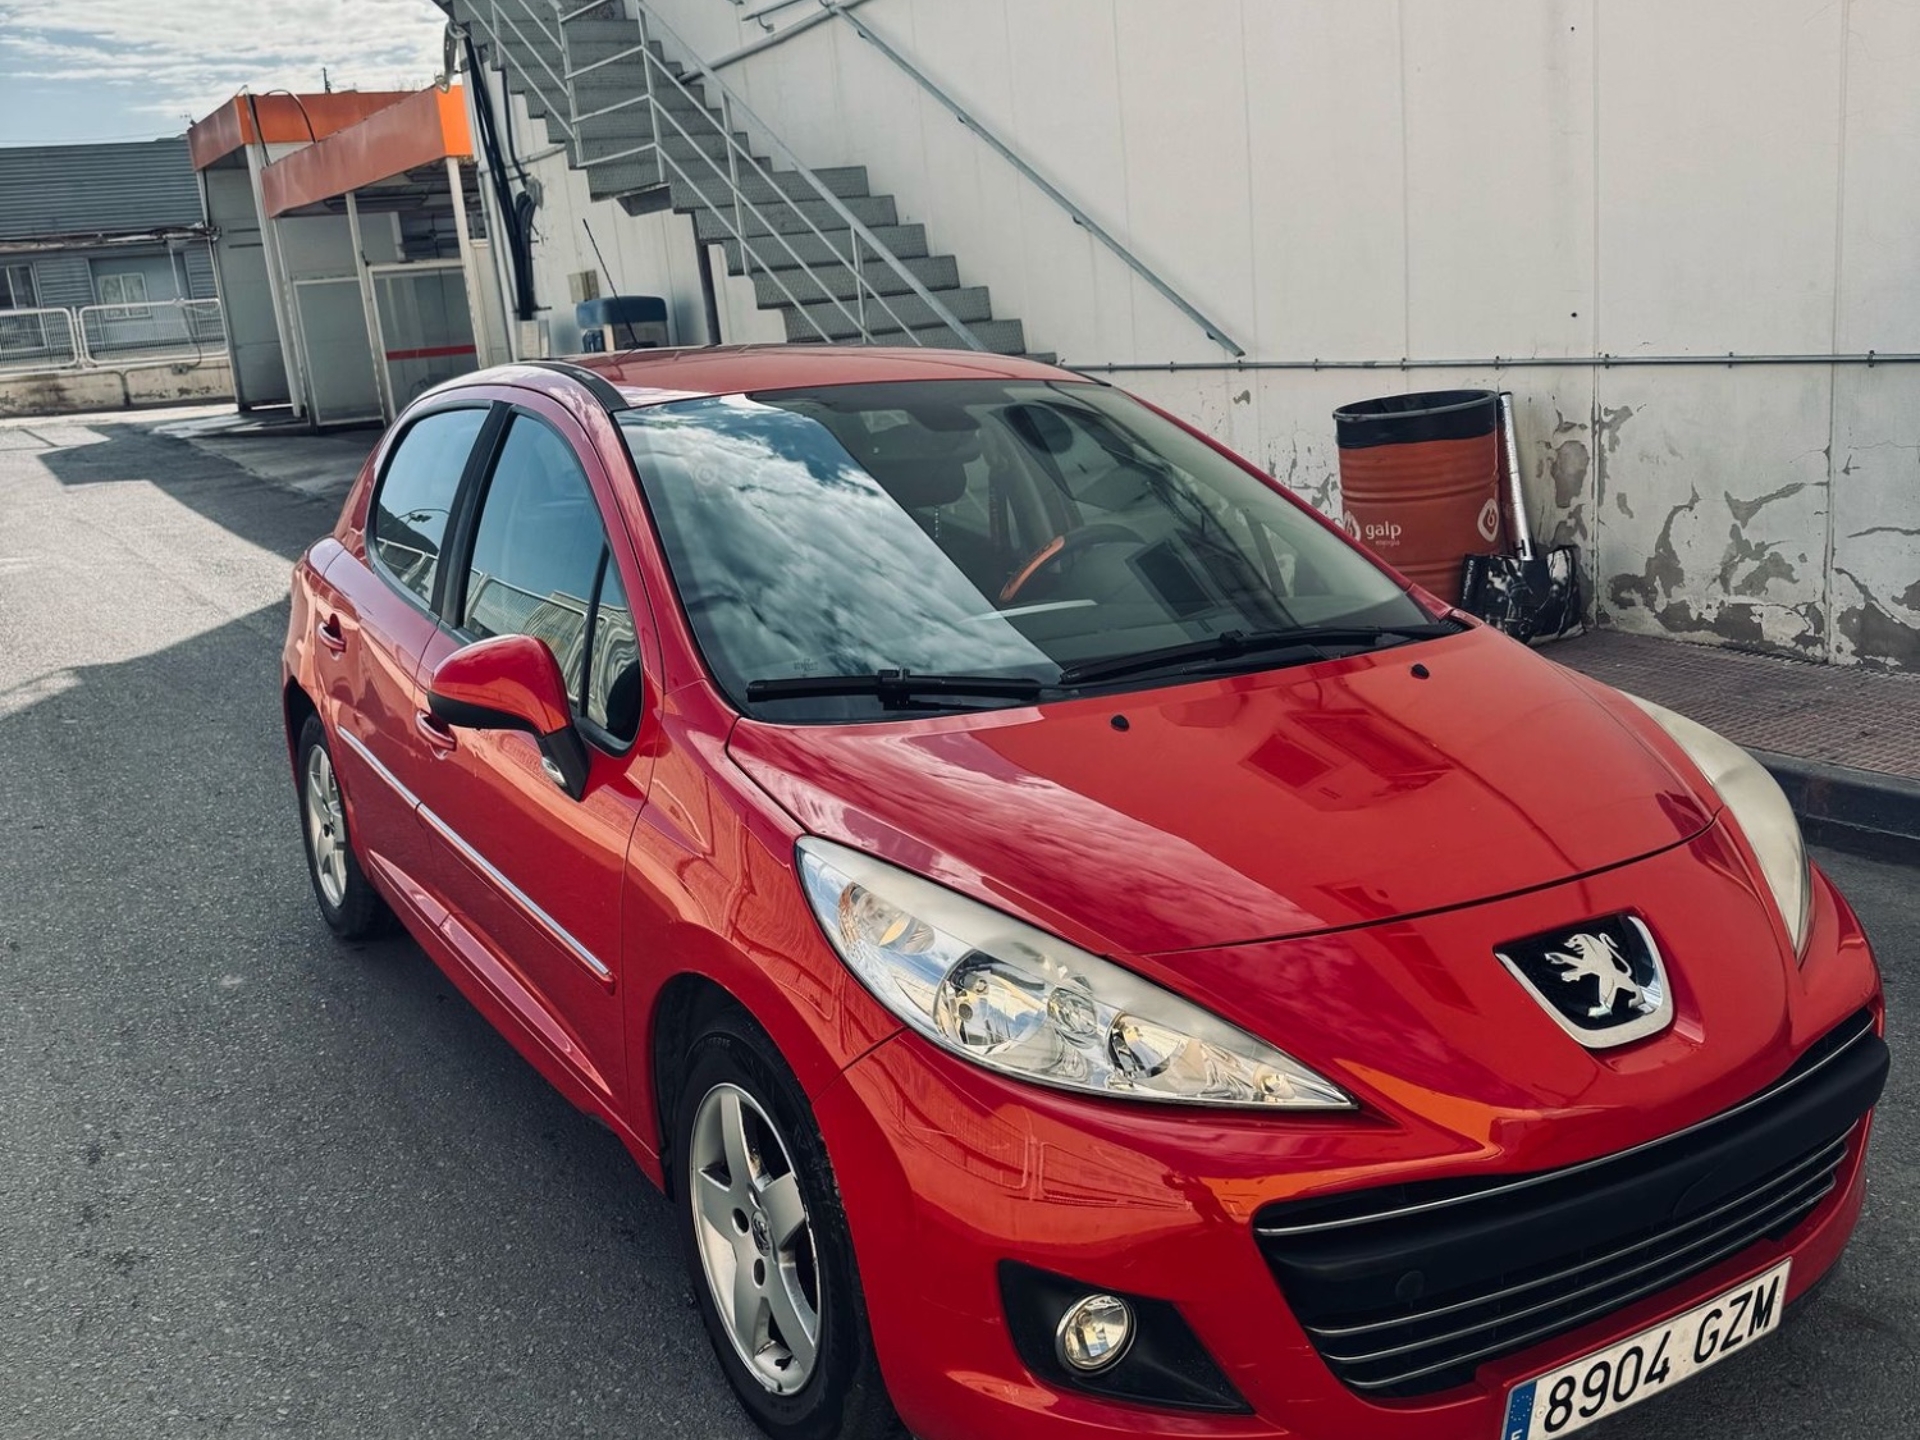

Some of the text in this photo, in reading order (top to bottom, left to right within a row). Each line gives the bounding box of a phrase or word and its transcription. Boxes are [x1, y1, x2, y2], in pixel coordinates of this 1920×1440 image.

[1365, 520, 1402, 539] galp
[1544, 1275, 1780, 1433] 8904 GZM
